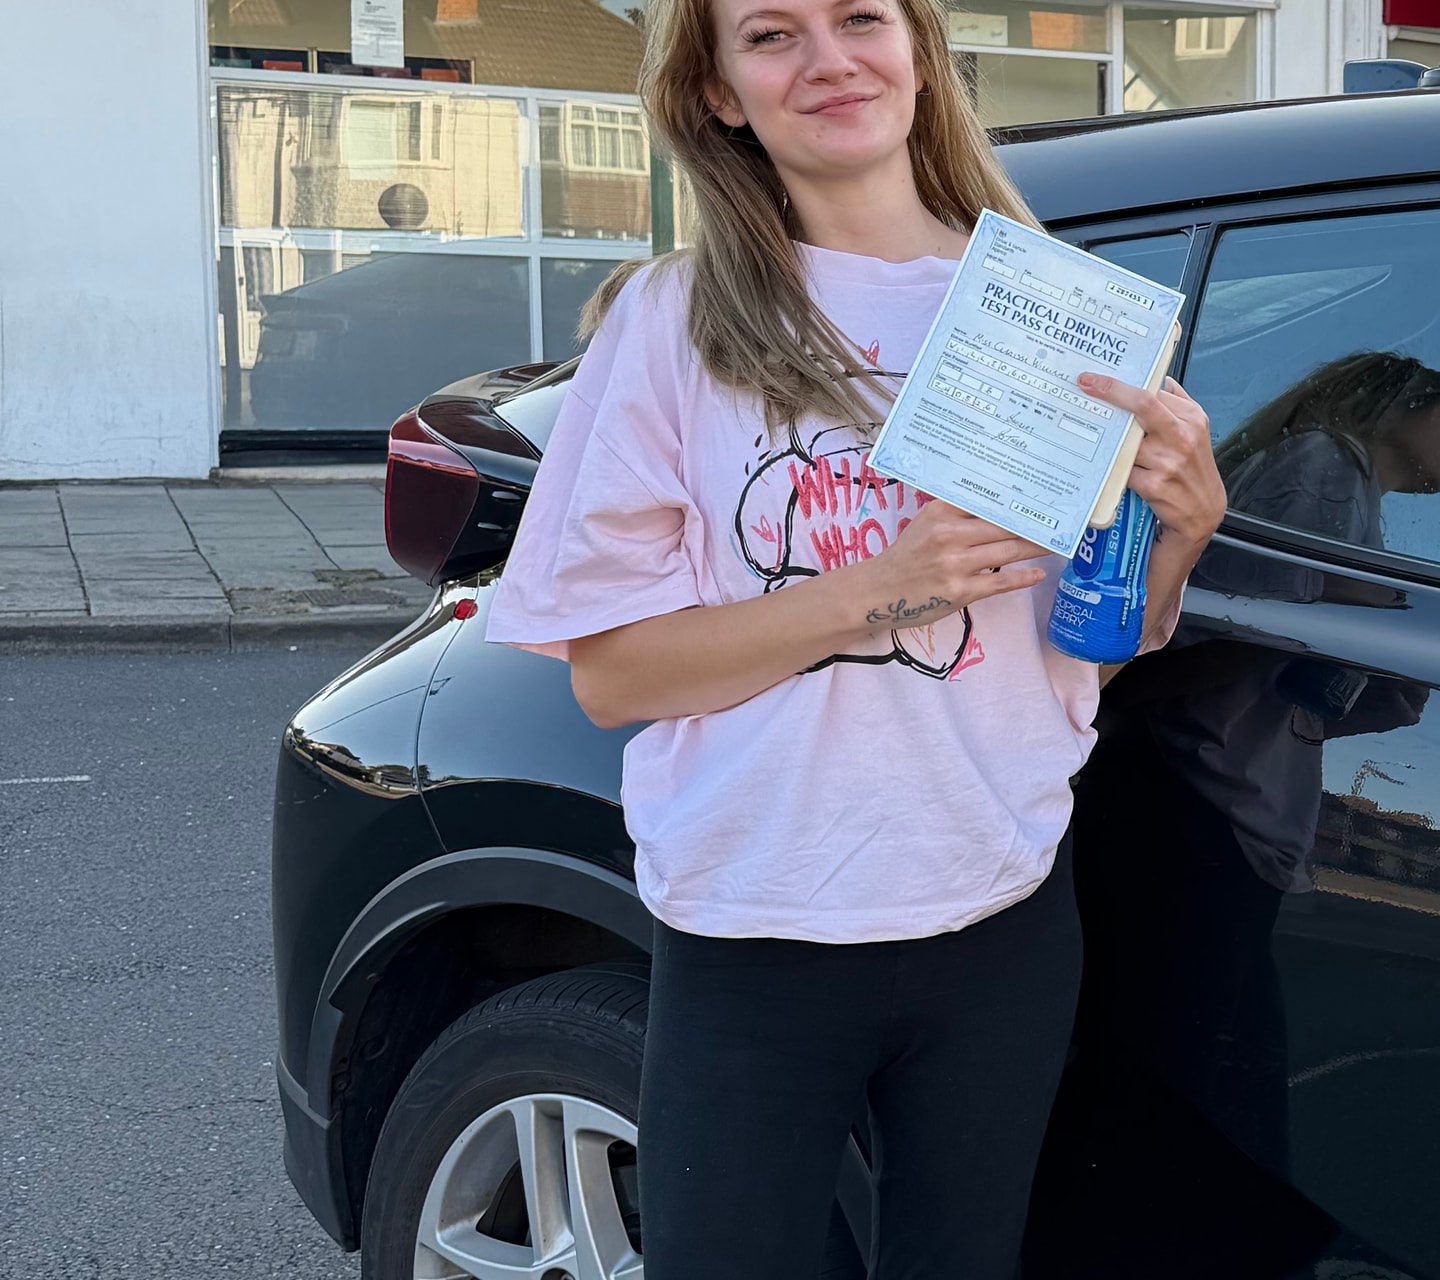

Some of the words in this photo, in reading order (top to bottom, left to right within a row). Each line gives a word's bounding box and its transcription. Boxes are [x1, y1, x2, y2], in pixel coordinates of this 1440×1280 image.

[981, 296, 1008, 317] TEST
[1011, 309, 1041, 332] PASS
[1044, 324, 1123, 367] CERTIFICATE
[985, 282, 1059, 325] PRACTICAL
[1064, 317, 1128, 353] DRIVING
[959, 476, 1001, 499] IMPORTANT
[1062, 582, 1090, 600] SPORT
